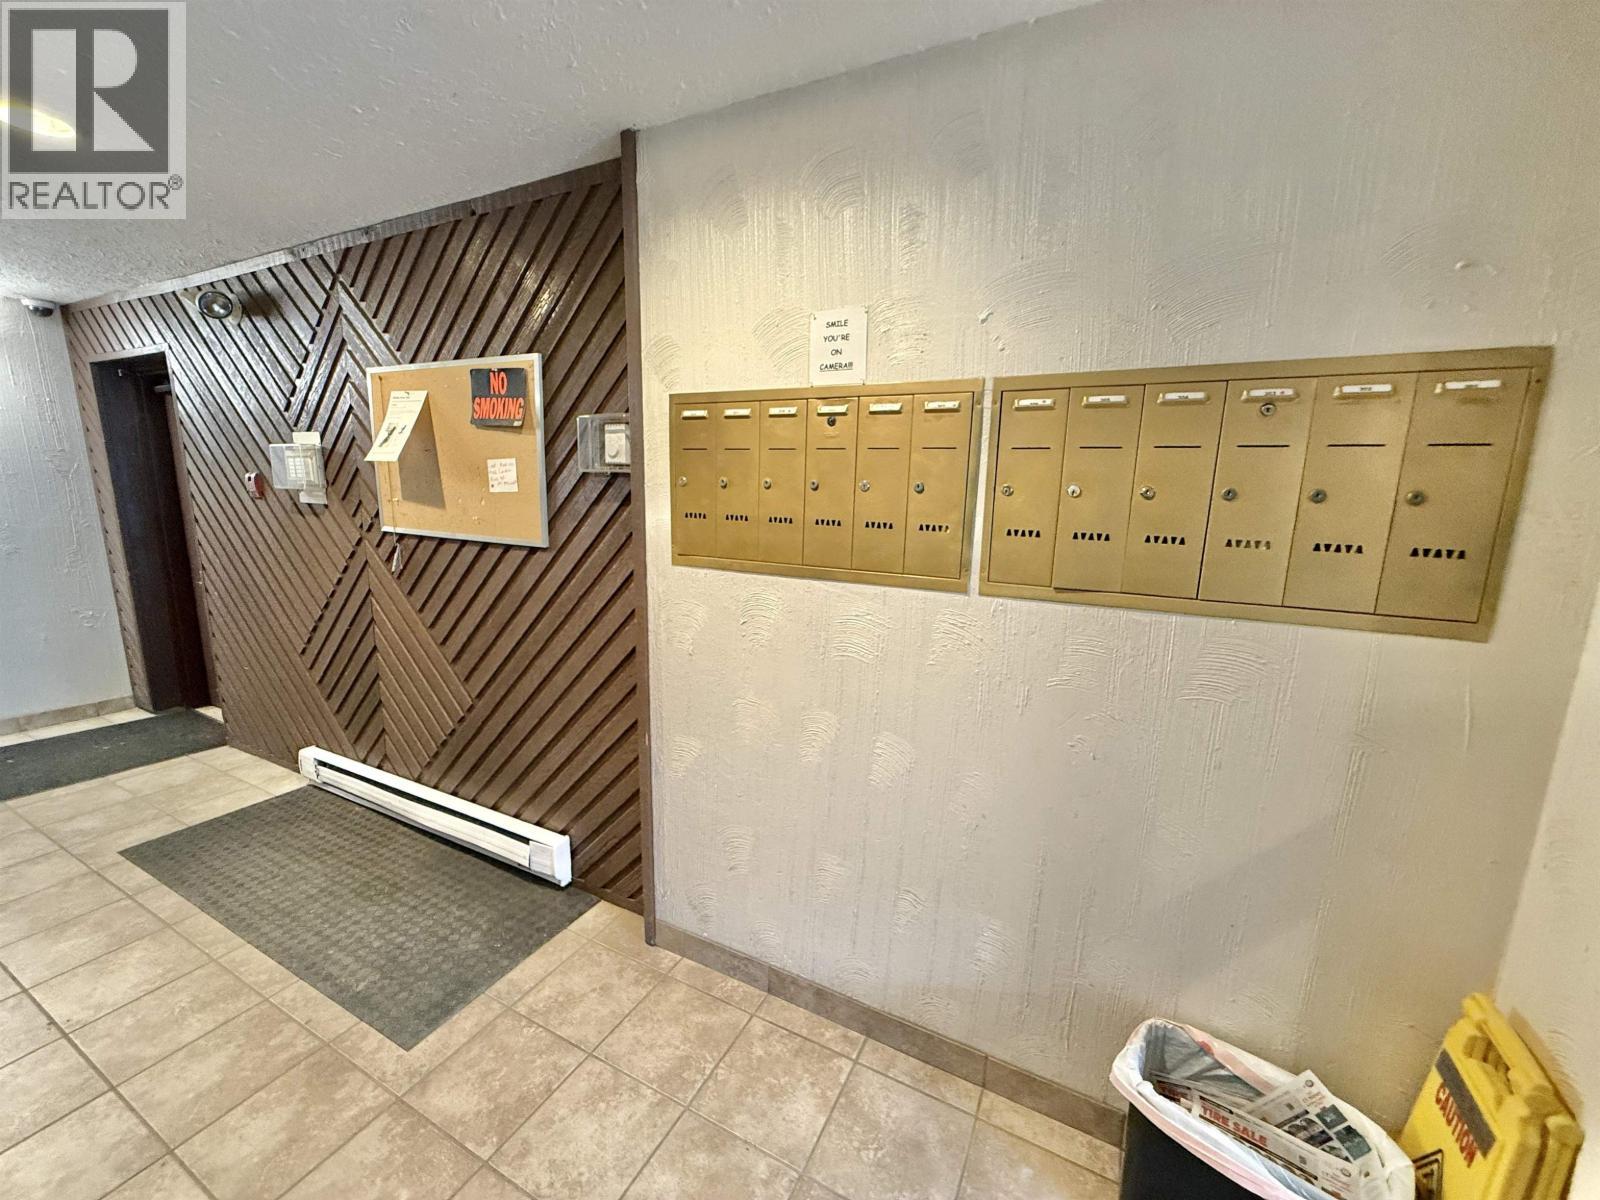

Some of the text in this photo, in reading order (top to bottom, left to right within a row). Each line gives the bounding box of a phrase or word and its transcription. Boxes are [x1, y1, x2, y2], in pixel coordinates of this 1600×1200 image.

[825, 319, 848, 328] SMILE
[823, 333, 850, 342] YOU'RE
[830, 348, 842, 356] ON
[490, 371, 507, 395] NO
[473, 397, 524, 420] SMOKING
[1201, 1105, 1268, 1147] TIRE SALE
[1435, 1081, 1479, 1168] CAUTION
